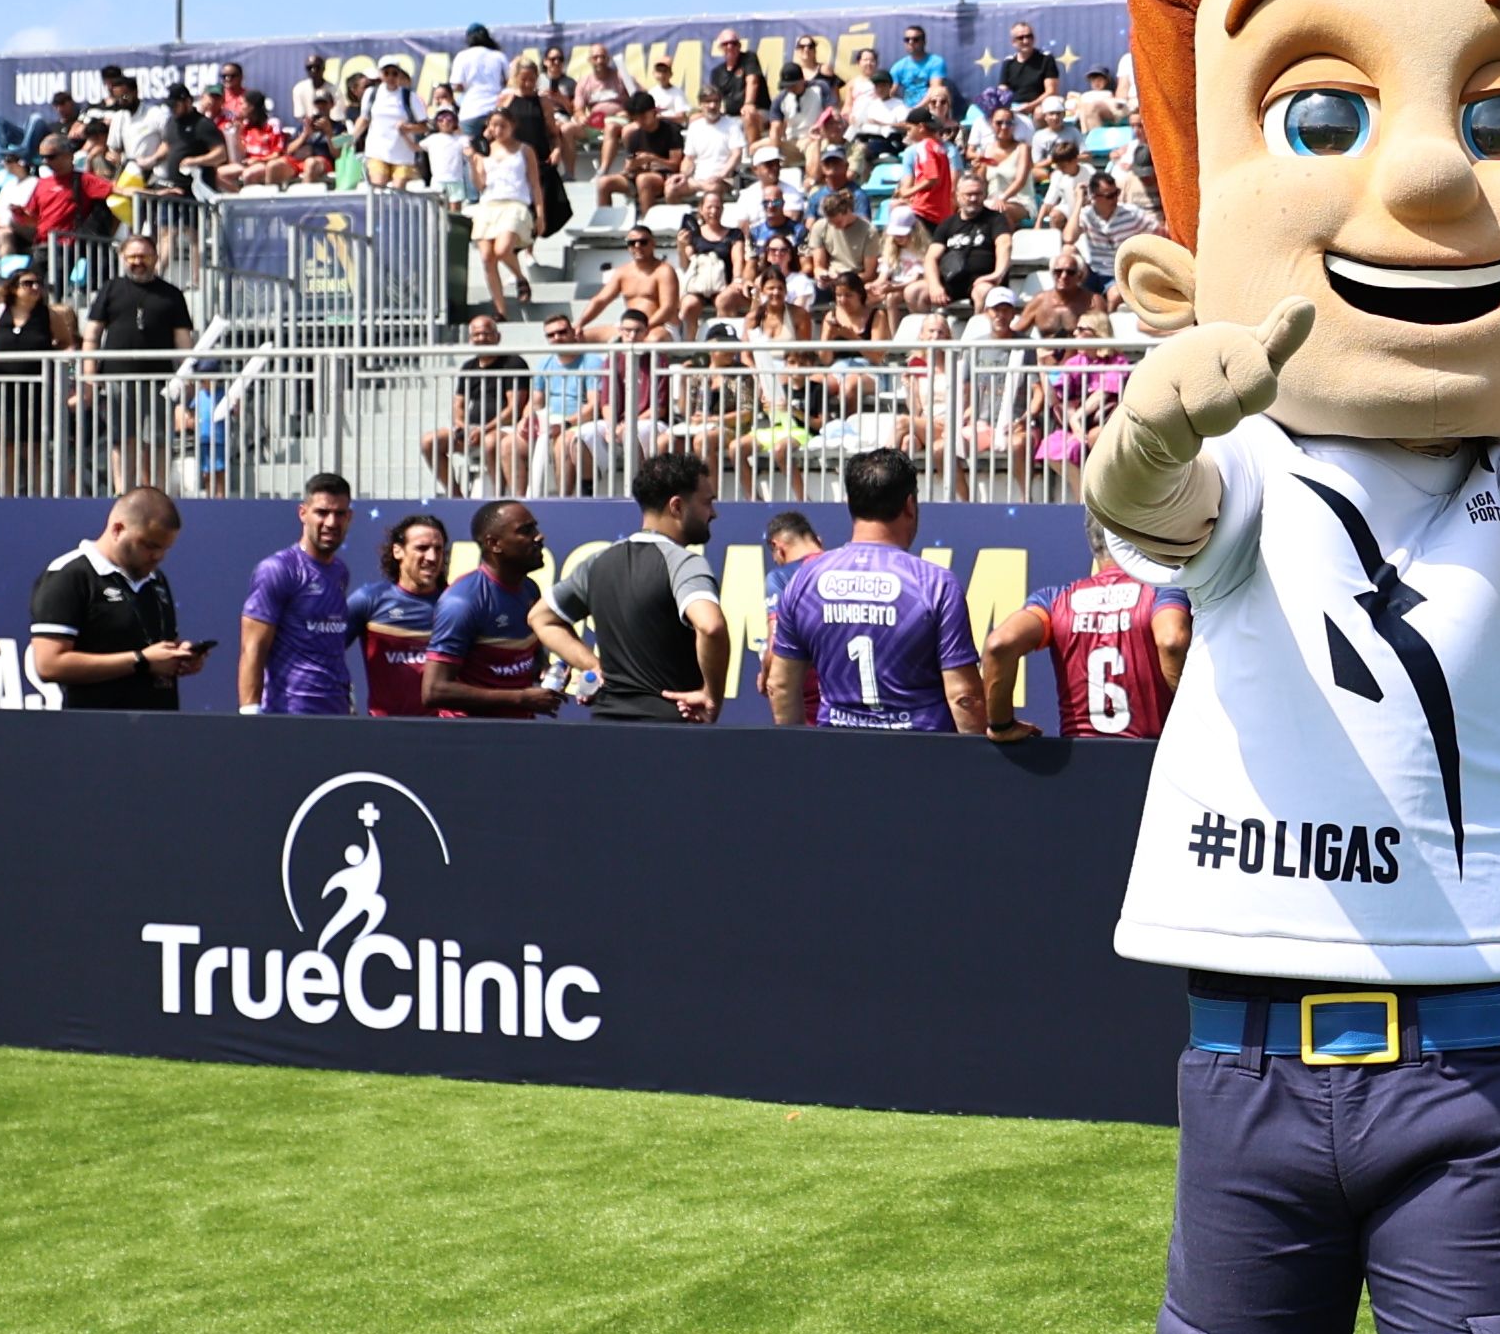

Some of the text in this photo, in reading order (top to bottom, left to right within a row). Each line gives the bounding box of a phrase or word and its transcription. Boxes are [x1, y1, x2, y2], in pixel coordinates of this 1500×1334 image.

[15, 70, 67, 105] NUM
[1465, 490, 1496, 512] LIGA
[825, 575, 892, 598] Agriloja
[823, 603, 897, 627] HUMBERTO
[847, 635, 884, 711] 1
[1087, 646, 1131, 734] 6
[142, 921, 601, 1042] TrueClinic
